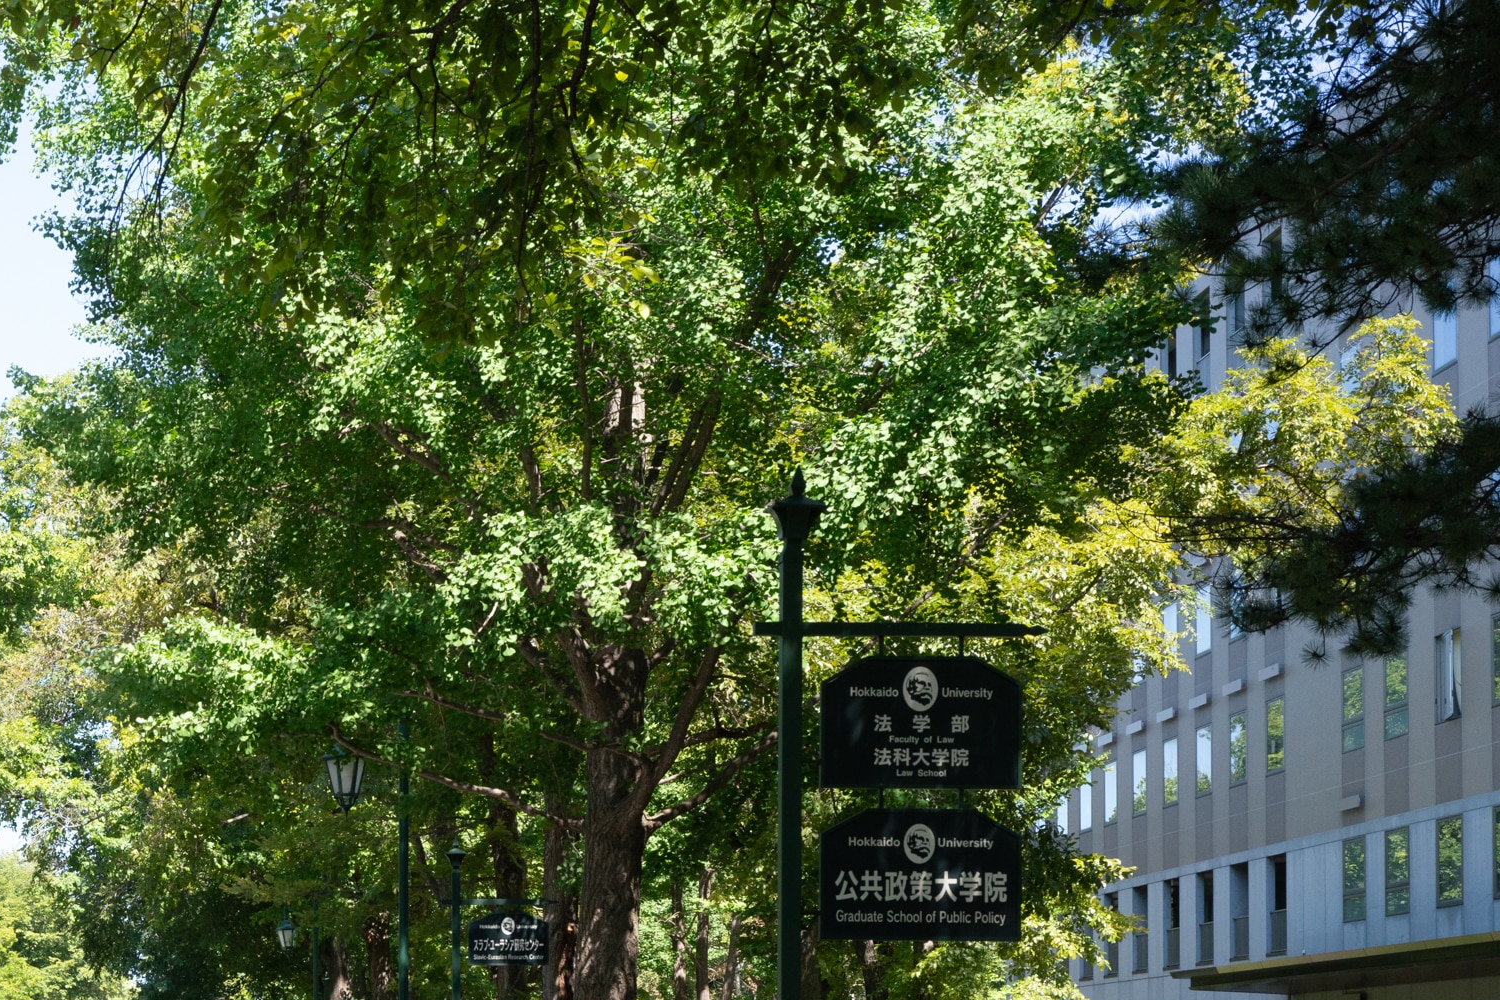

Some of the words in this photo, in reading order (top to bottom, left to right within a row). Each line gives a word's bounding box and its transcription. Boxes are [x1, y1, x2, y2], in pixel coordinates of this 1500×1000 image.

[850, 686, 899, 698] Hokkaido
[941, 687, 993, 700] University
[889, 735, 919, 745] Faculty
[924, 735, 933, 744] of
[936, 736, 955, 744] Law
[873, 748, 970, 767] 法科大学院
[896, 769, 914, 777] Law
[917, 768, 947, 778] School
[848, 836, 901, 848] Hokkaido
[937, 837, 994, 850] University
[834, 870, 1008, 903] 公共政策大学院
[835, 909, 884, 923] Graduate
[886, 909, 923, 923] School
[925, 911, 937, 924] of
[939, 911, 972, 924] Public
[974, 911, 1006, 927] Policy
